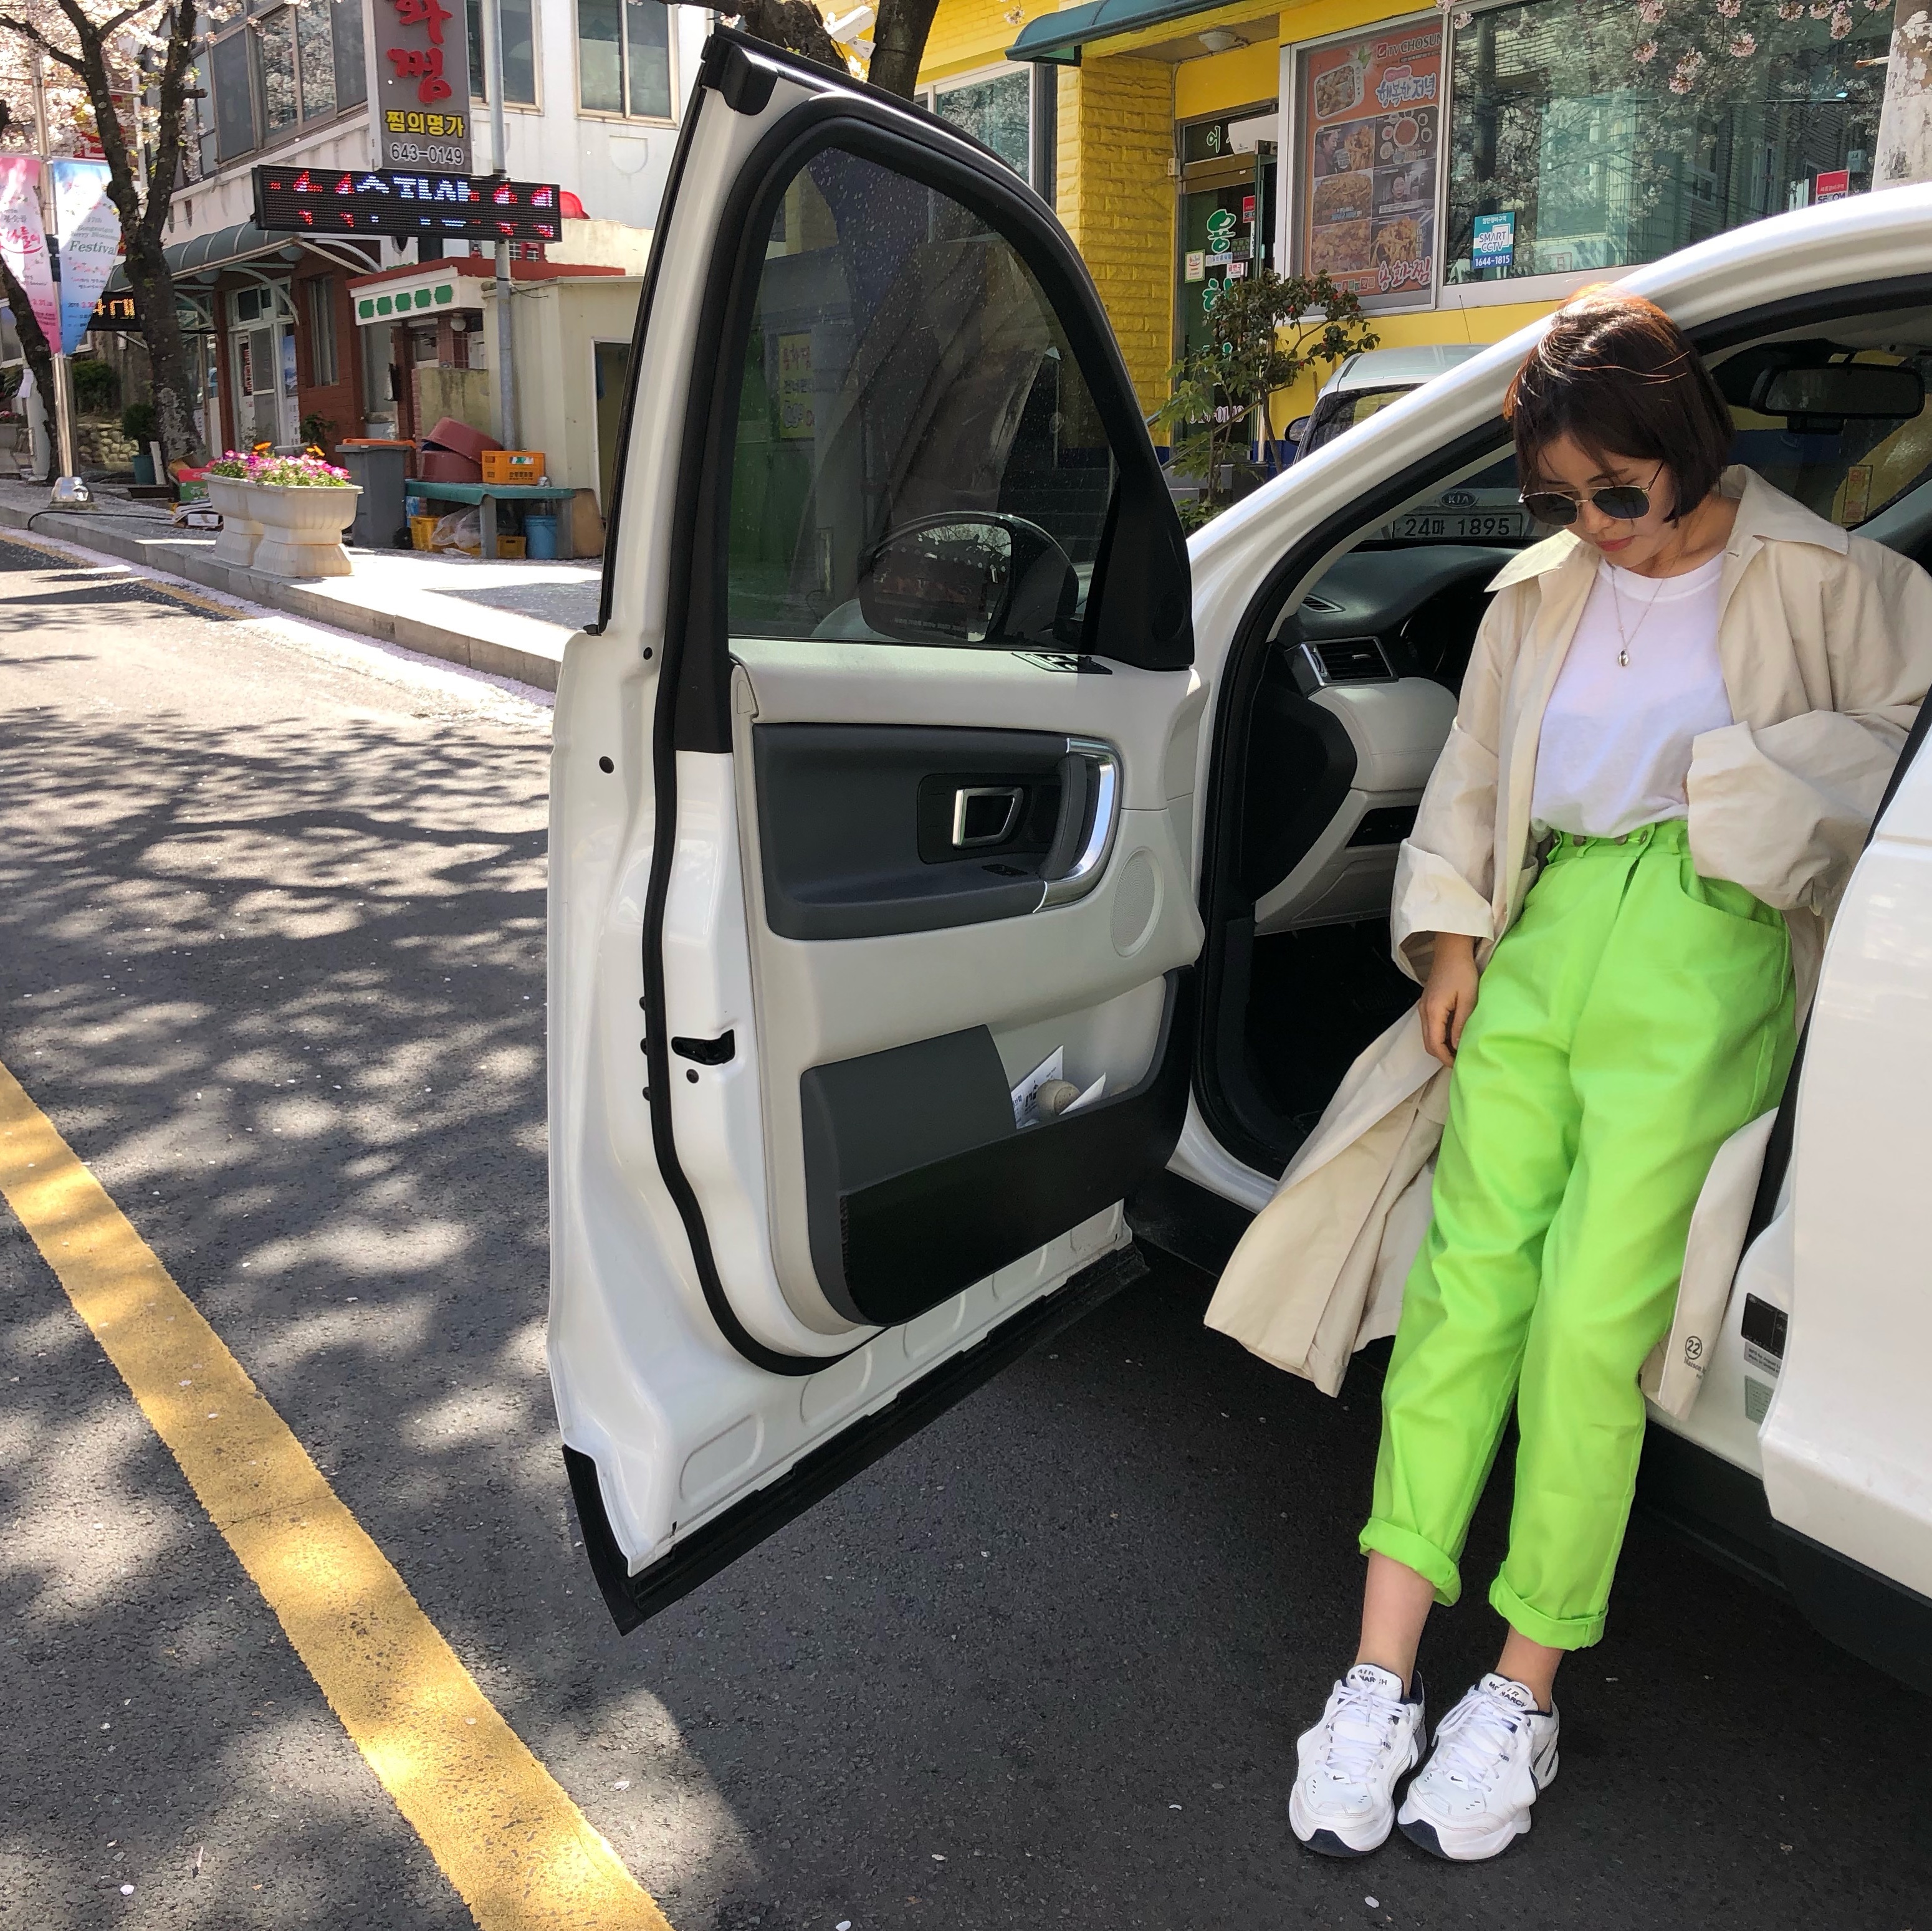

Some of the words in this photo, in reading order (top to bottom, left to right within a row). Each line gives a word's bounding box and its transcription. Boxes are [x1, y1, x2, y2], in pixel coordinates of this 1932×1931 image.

[1376, 79, 1412, 107] 행복한
[1411, 73, 1435, 98] 저녁
[386, 110, 464, 138] 찜의명가
[390, 143, 464, 165] 643-0149
[1479, 231, 1507, 243] SMART
[69, 241, 116, 255] Festiva
[1475, 254, 1510, 267] 1644-1815
[1448, 495, 1470, 503] KIA
[1404, 518, 1445, 536] 24마
[1457, 517, 1510, 536] 1895
[1687, 1339, 1701, 1355] 22
